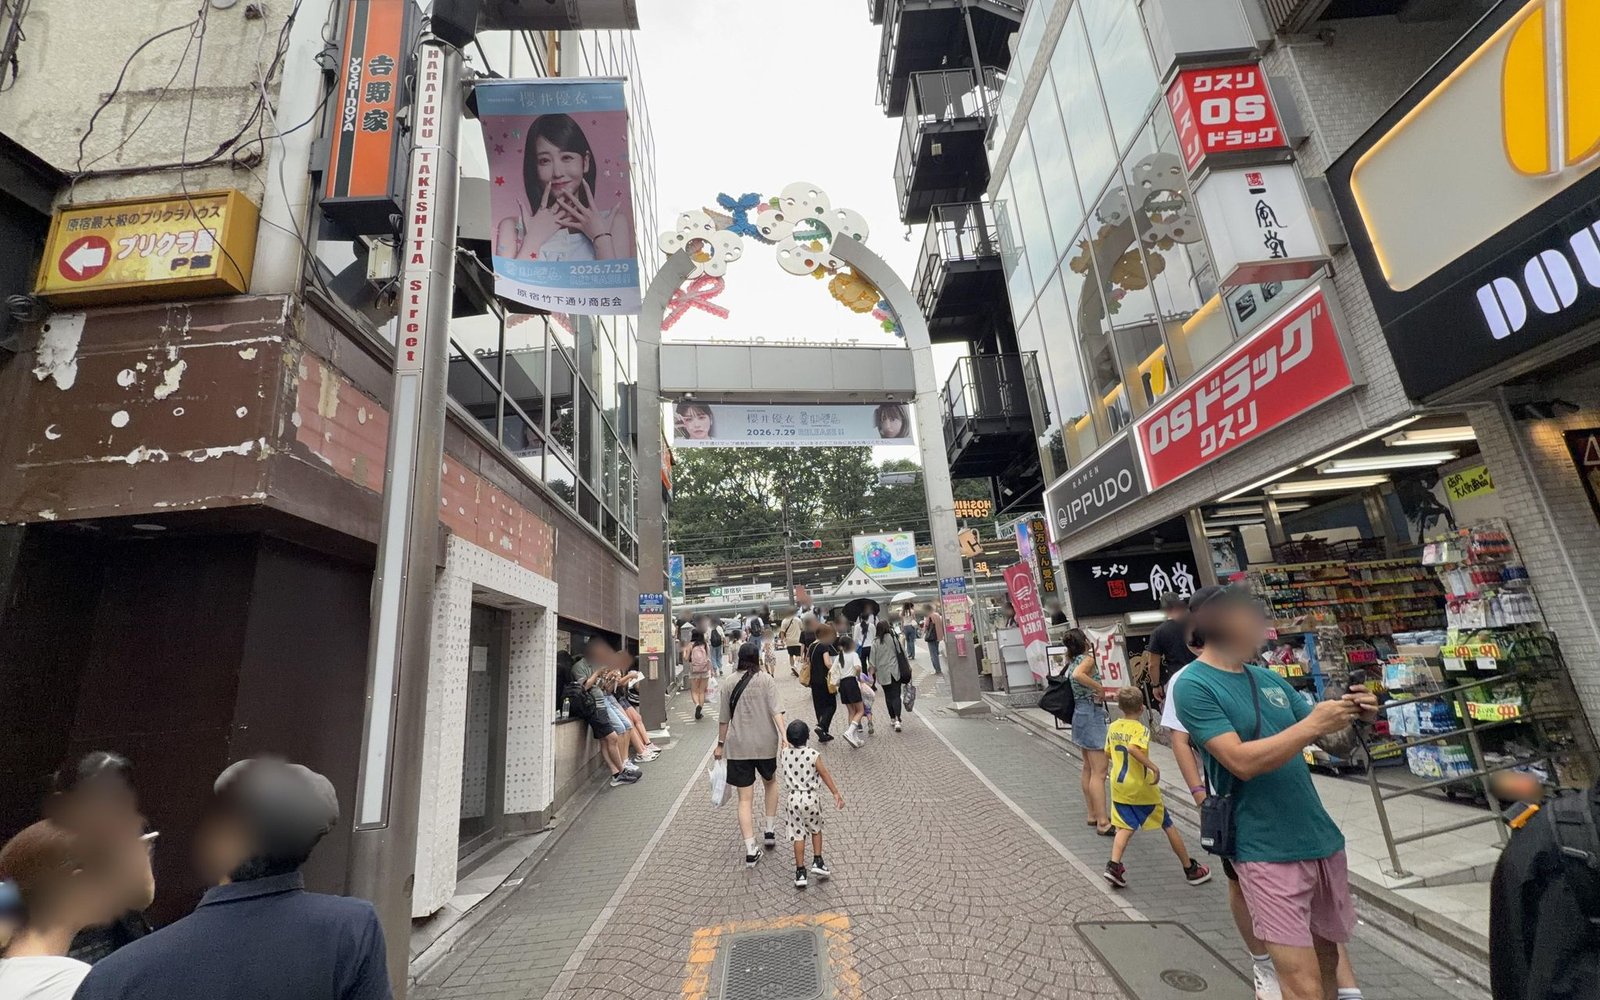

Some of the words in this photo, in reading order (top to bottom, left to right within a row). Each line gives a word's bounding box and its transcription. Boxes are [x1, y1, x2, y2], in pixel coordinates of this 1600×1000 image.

[342, 57, 362, 132] YOSHINOYA
[361, 54, 396, 133] 吉野家
[420, 50, 440, 139] HARAJUKU
[1194, 72, 1255, 93] クスリ
[1200, 95, 1266, 125] OS
[1207, 127, 1277, 147] ドラッグ
[66, 205, 221, 232] 原宿最大級のプリクラハウス
[410, 152, 431, 265] TAKESHITA
[569, 263, 630, 275] 2026.7.29
[517, 288, 622, 307] 原宿竹下通り商店会
[404, 280, 423, 362] Street
[1149, 302, 1321, 456] OSドラッグ
[746, 428, 796, 436] 2026.7.29
[1200, 400, 1258, 458] クスリ
[1072, 465, 1100, 489] RAMEN
[1067, 468, 1132, 524] IPPUDO
[1033, 520, 1054, 592] 処方せん受付
[1092, 563, 1129, 578] ラーメン
[1108, 662, 1123, 681] B1
[1114, 744, 1129, 783] 7
